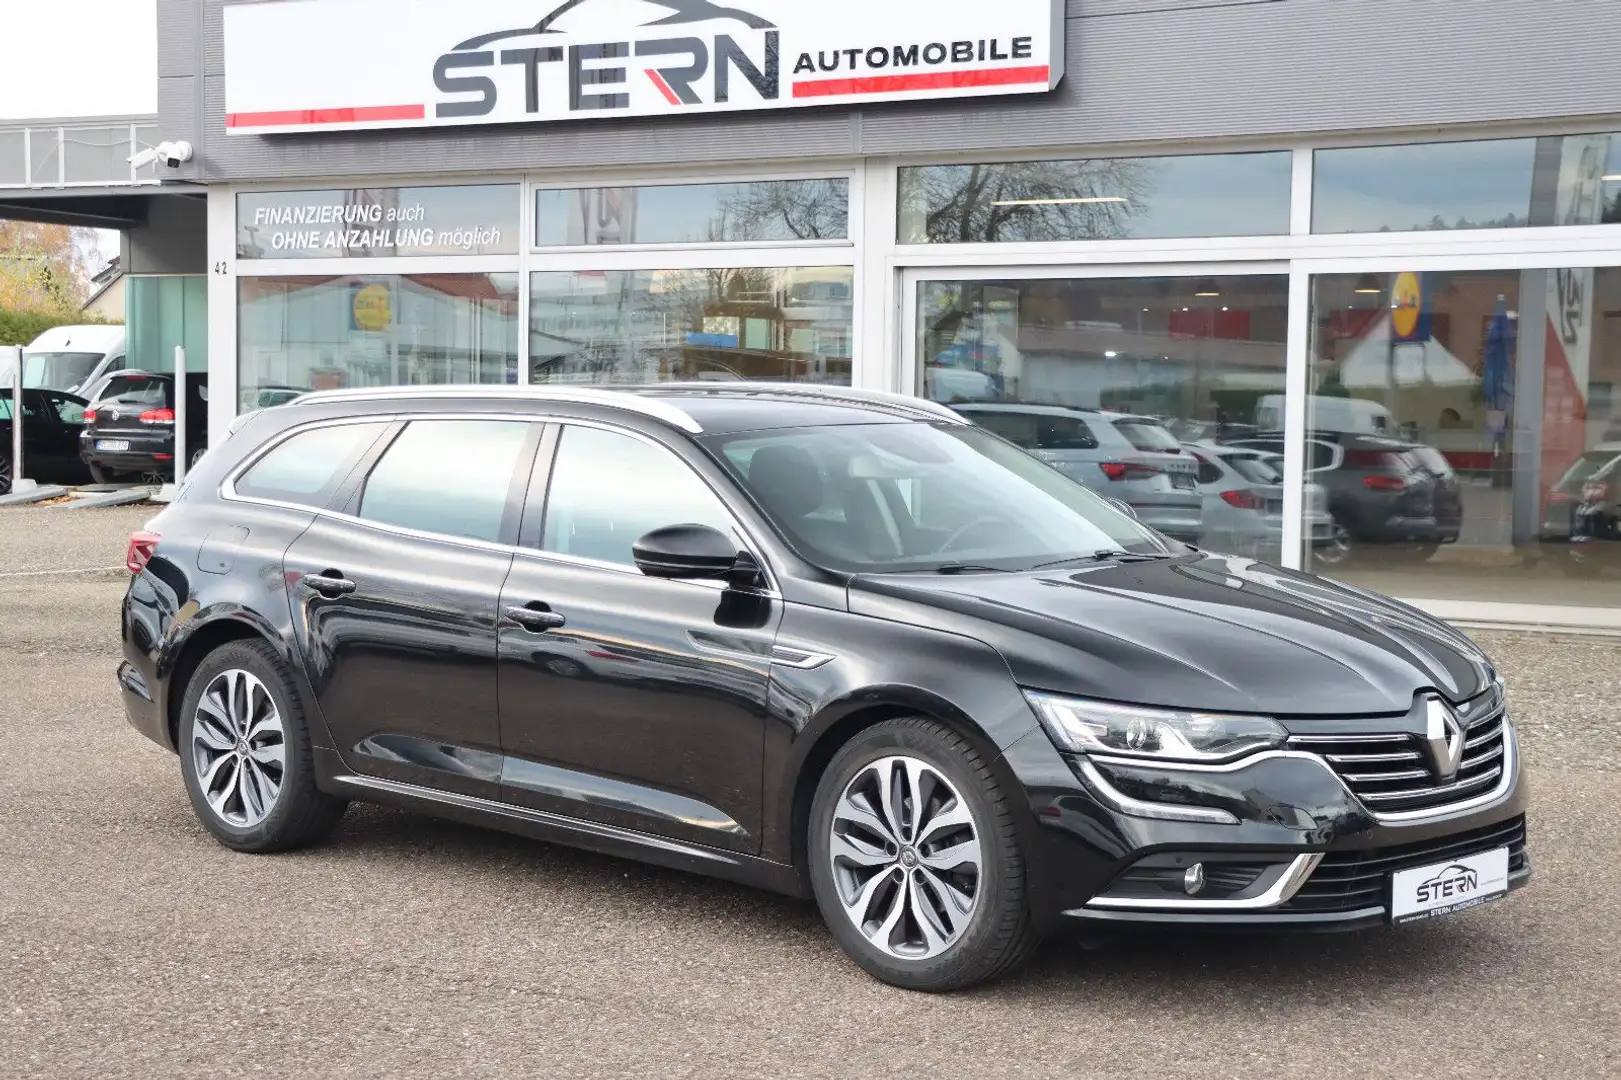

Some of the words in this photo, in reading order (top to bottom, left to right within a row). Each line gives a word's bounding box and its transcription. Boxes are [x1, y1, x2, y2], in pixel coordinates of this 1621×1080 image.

[432, 30, 780, 118] STERN
[793, 36, 1032, 74] AUTOMOBILE
[254, 204, 382, 225] FINANZIERUNG
[386, 203, 425, 221] auch
[271, 231, 320, 249] OHNE
[324, 228, 434, 248] ANZAHLUNG
[438, 225, 501, 250] möglich
[214, 261, 228, 275] 42
[1416, 872, 1478, 903] STERN
[1430, 905, 1452, 917] STERN
